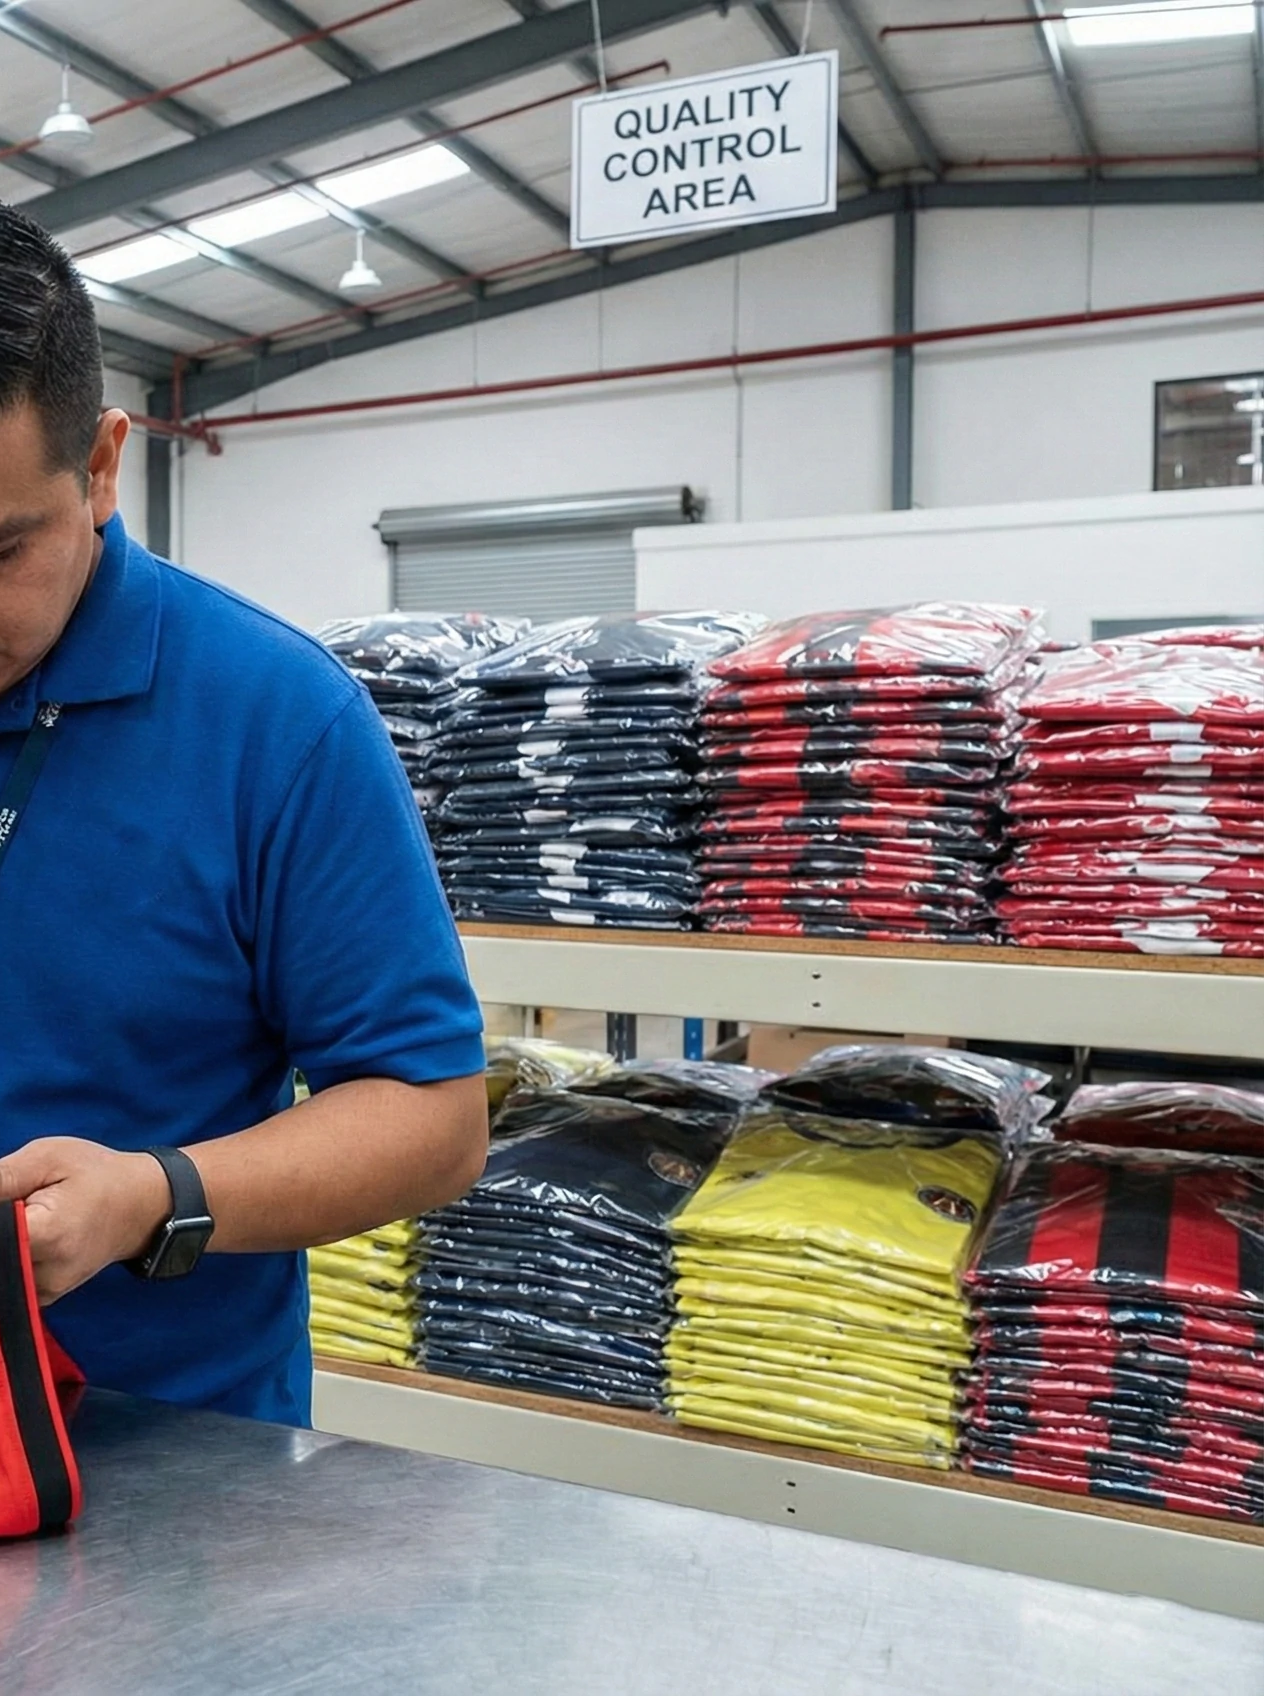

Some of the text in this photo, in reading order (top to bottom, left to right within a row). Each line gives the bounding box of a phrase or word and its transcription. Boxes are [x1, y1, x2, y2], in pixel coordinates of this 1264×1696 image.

[614, 81, 790, 139] QUALITY
[604, 124, 802, 182] CONTROL
[643, 174, 756, 218] AREA
